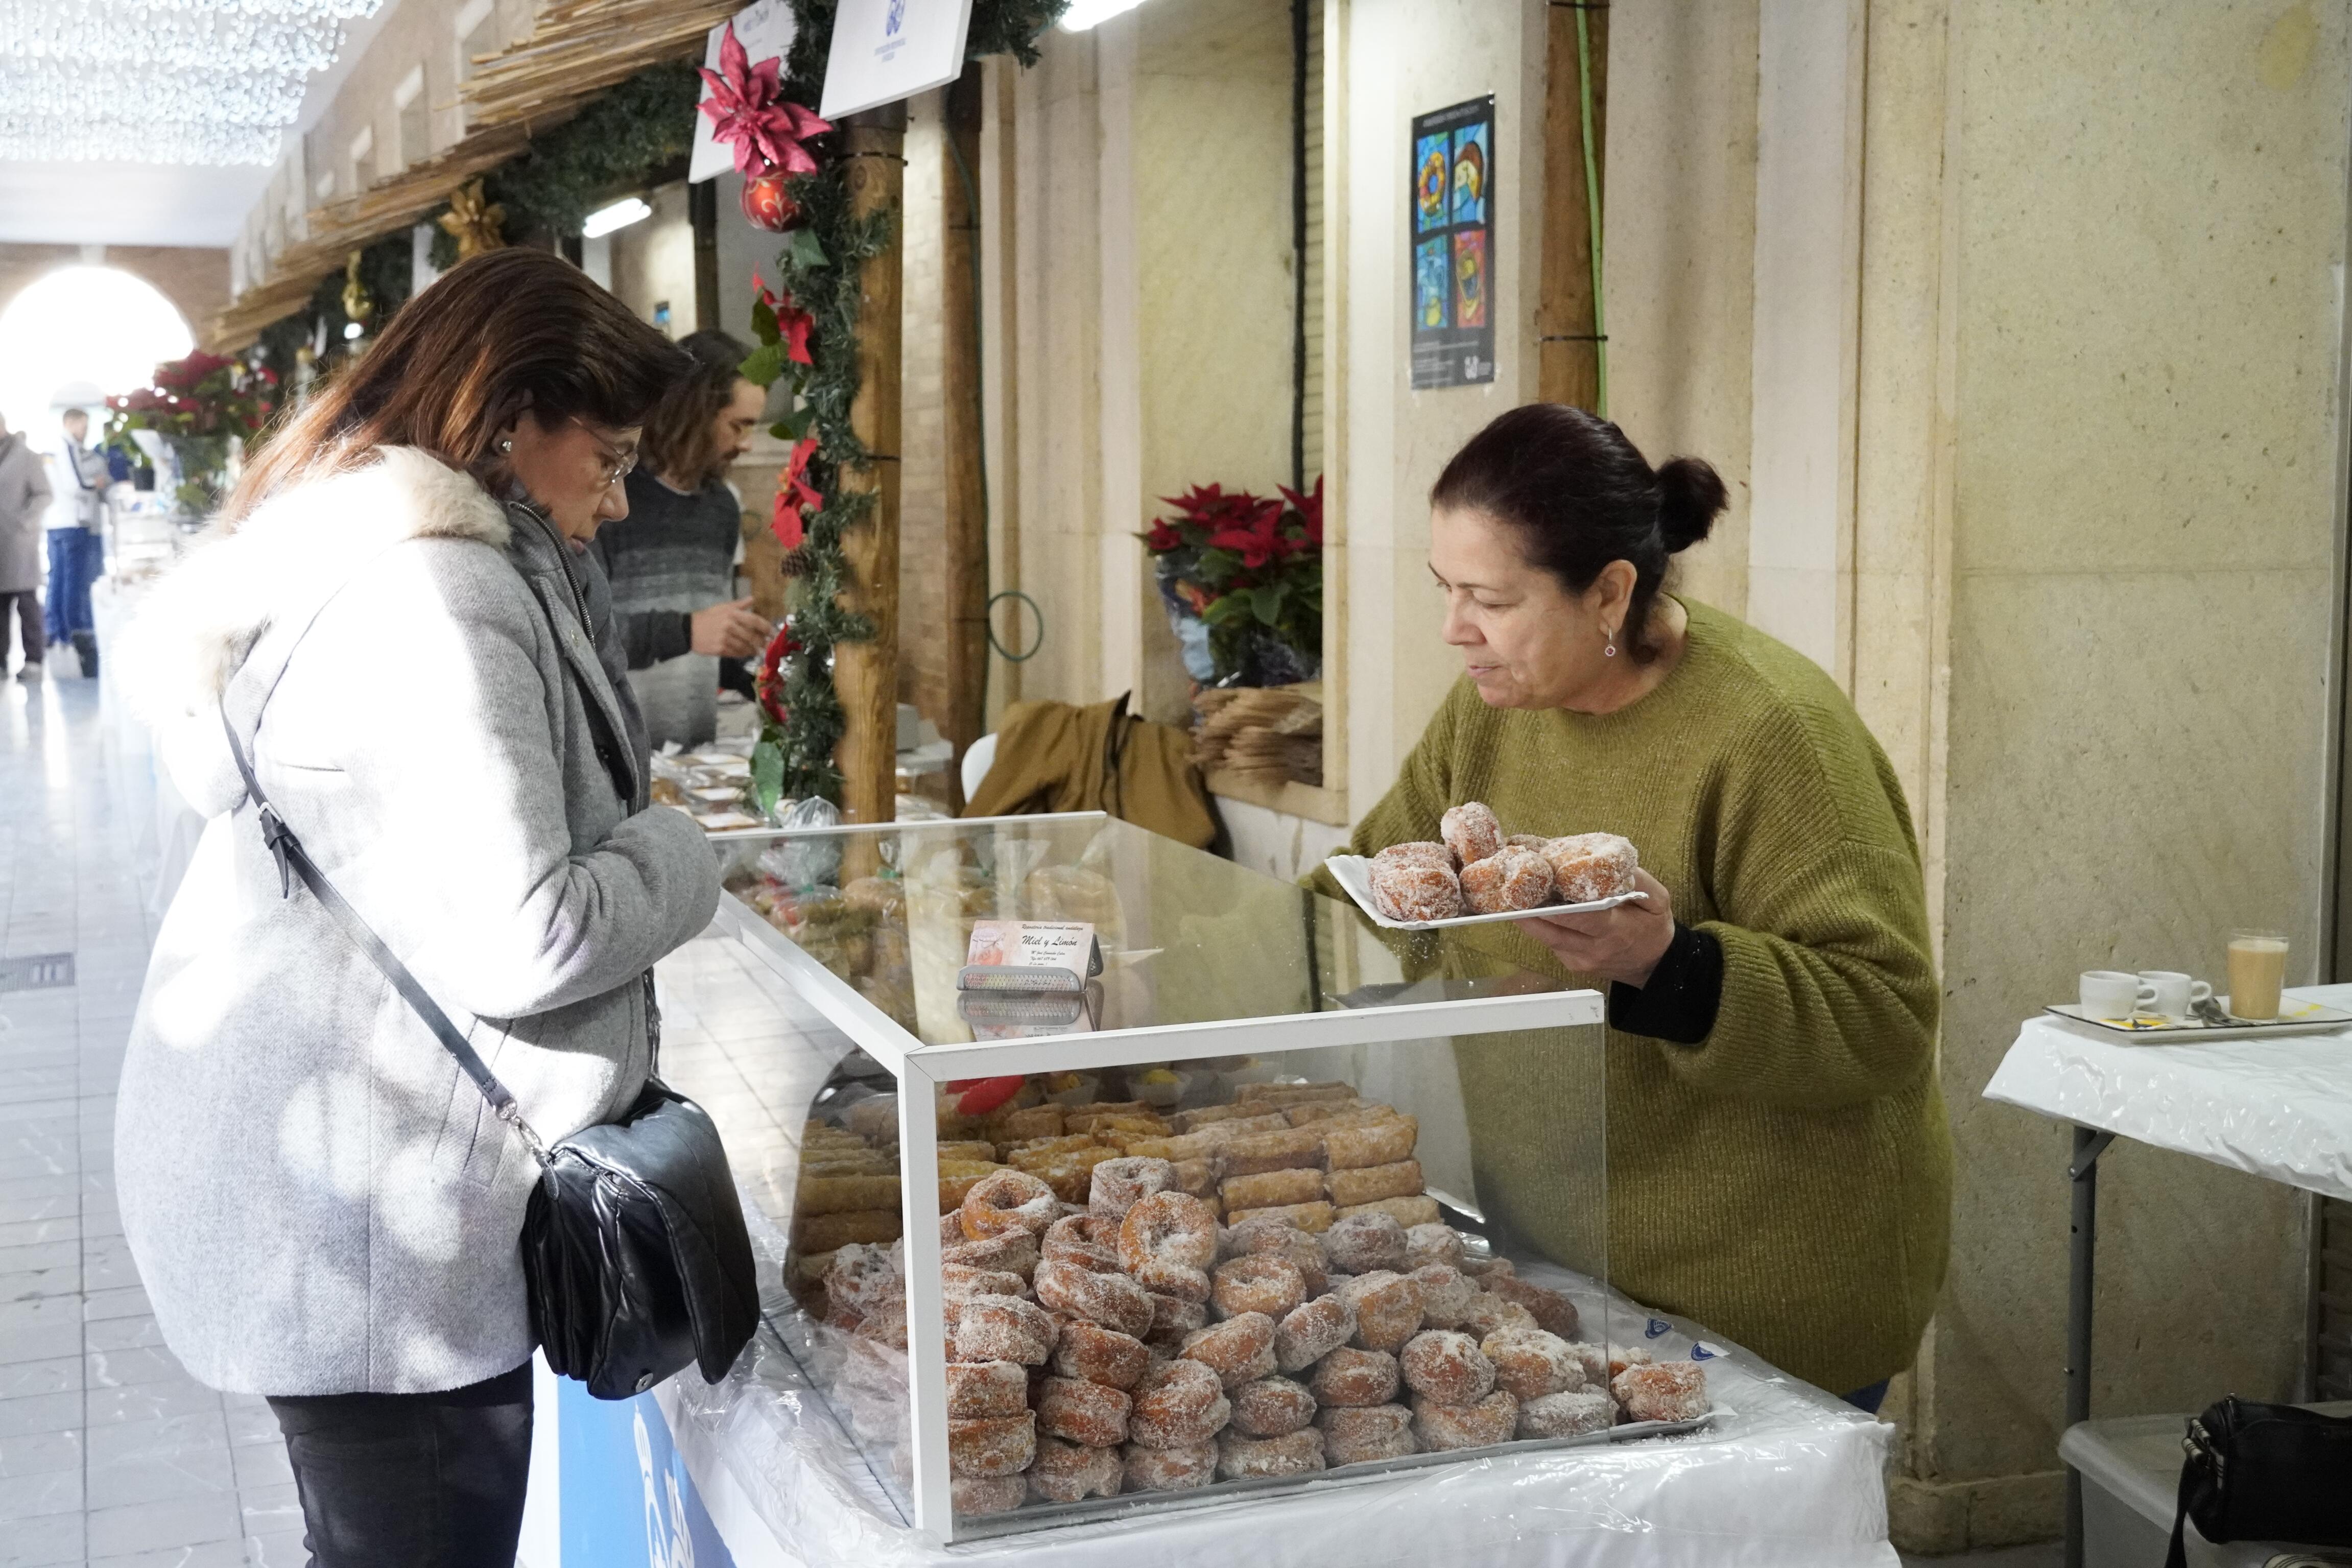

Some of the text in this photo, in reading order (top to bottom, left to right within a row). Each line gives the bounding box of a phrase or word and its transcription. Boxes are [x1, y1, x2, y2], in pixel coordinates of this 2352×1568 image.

[1022, 935, 1078, 947] Miel y Limón
